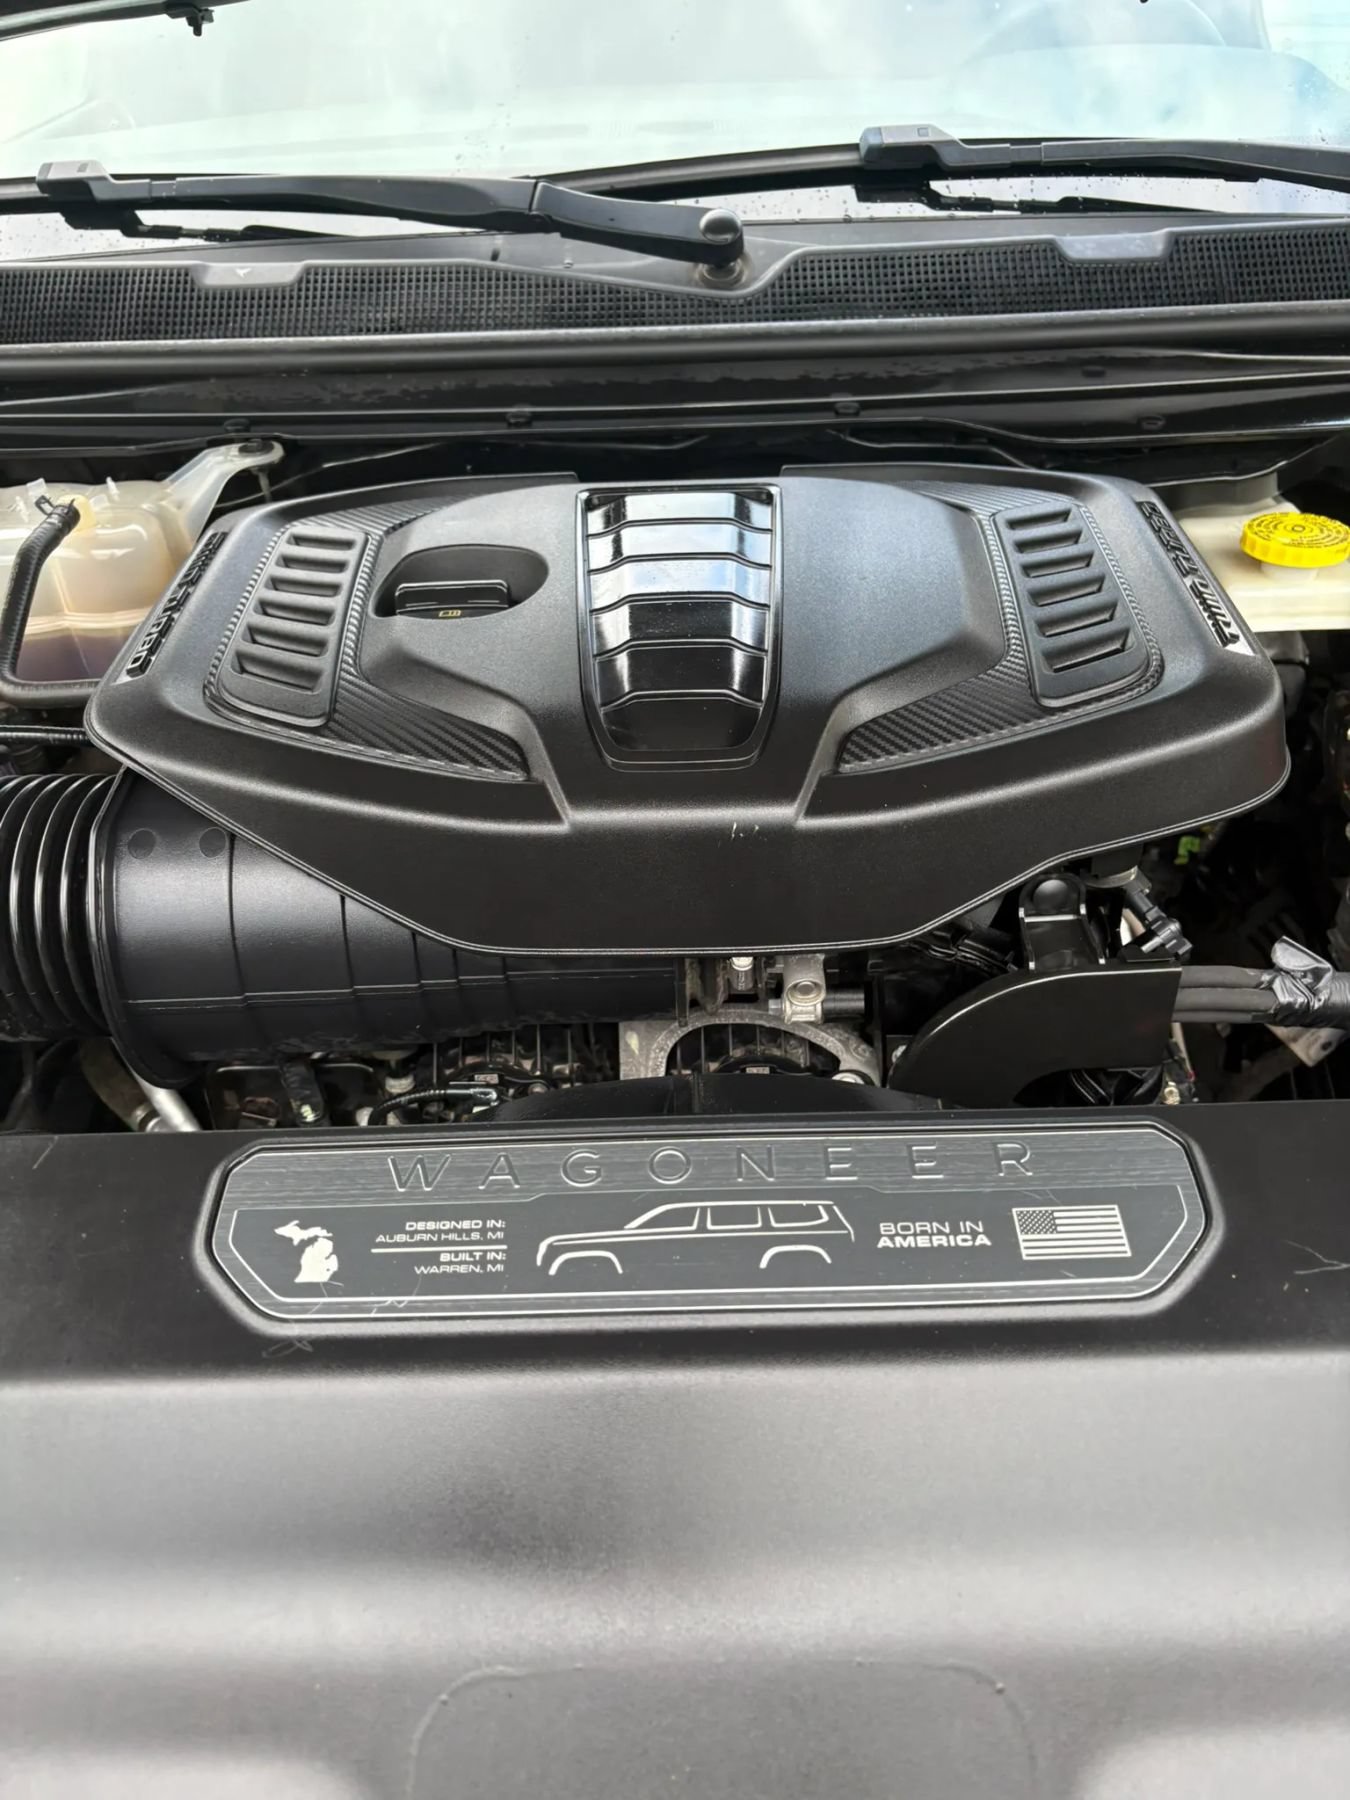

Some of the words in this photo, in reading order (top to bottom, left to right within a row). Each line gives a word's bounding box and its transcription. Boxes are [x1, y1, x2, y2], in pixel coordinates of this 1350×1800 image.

[126, 585, 191, 677] TURBO
[387, 1143, 1034, 1192] WAGONEER
[405, 1220, 483, 1231] DESIGNED
[486, 1219, 506, 1229] IN:
[879, 1221, 950, 1235] BORN
[960, 1220, 984, 1233] IN
[375, 1233, 438, 1243] AUBURN
[487, 1231, 505, 1240] MI
[877, 1234, 992, 1248] AMERICA
[439, 1252, 483, 1262] BUILT
[486, 1251, 507, 1261] IN:
[486, 1263, 505, 1273] MI
